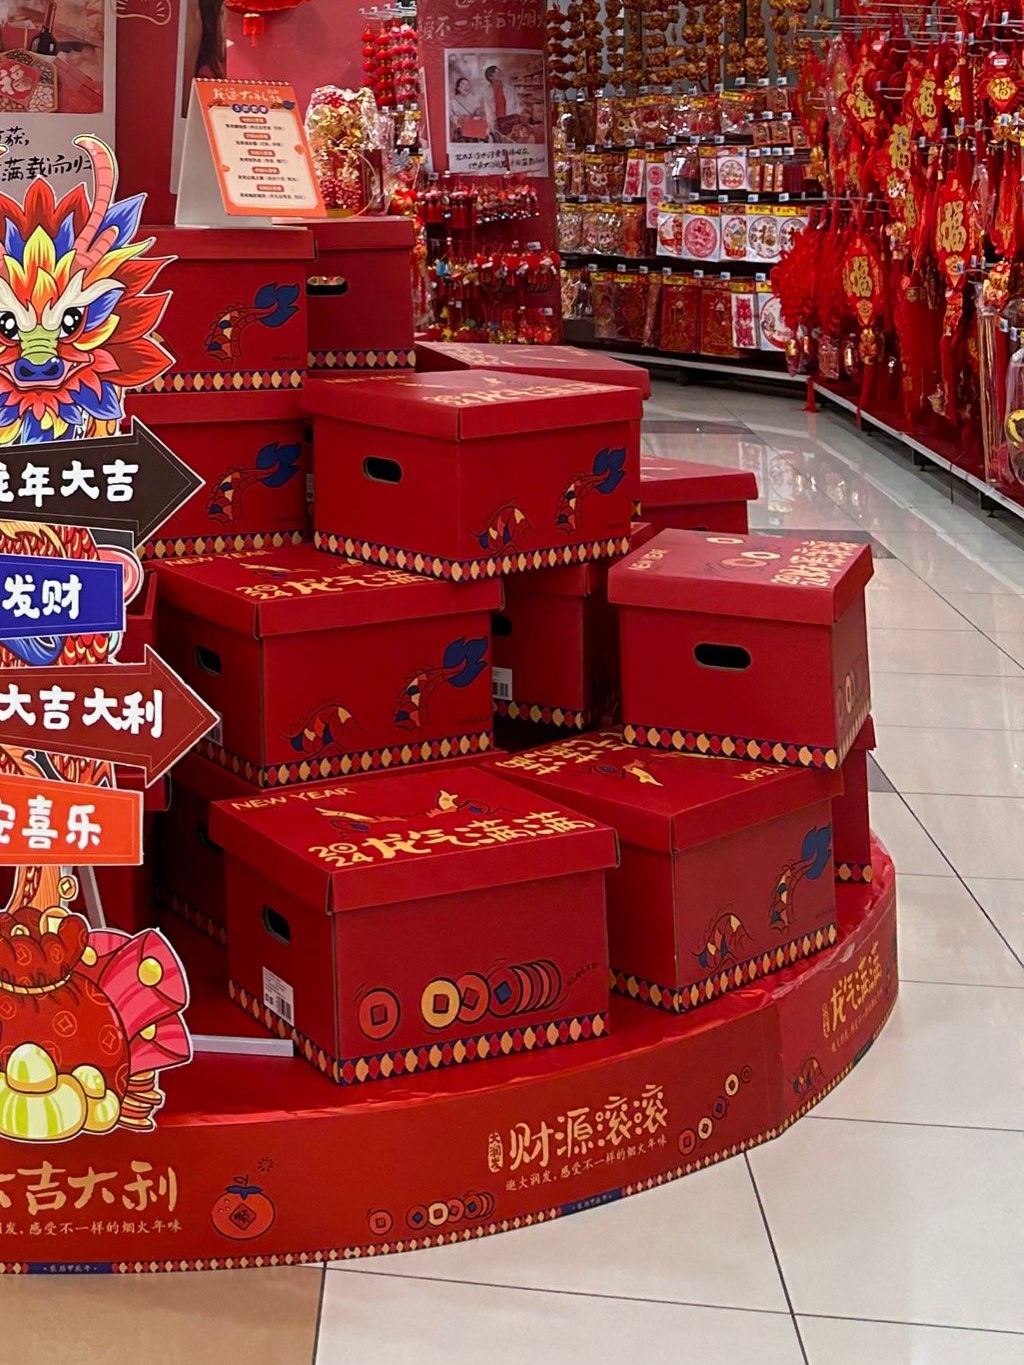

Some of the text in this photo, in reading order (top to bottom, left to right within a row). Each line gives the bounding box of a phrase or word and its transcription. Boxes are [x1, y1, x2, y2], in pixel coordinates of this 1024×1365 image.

[231, 786, 357, 812] NEW YEAR
[362, 810, 597, 860] 龙气满满
[510, 1085, 668, 1171] 财源滚滚
